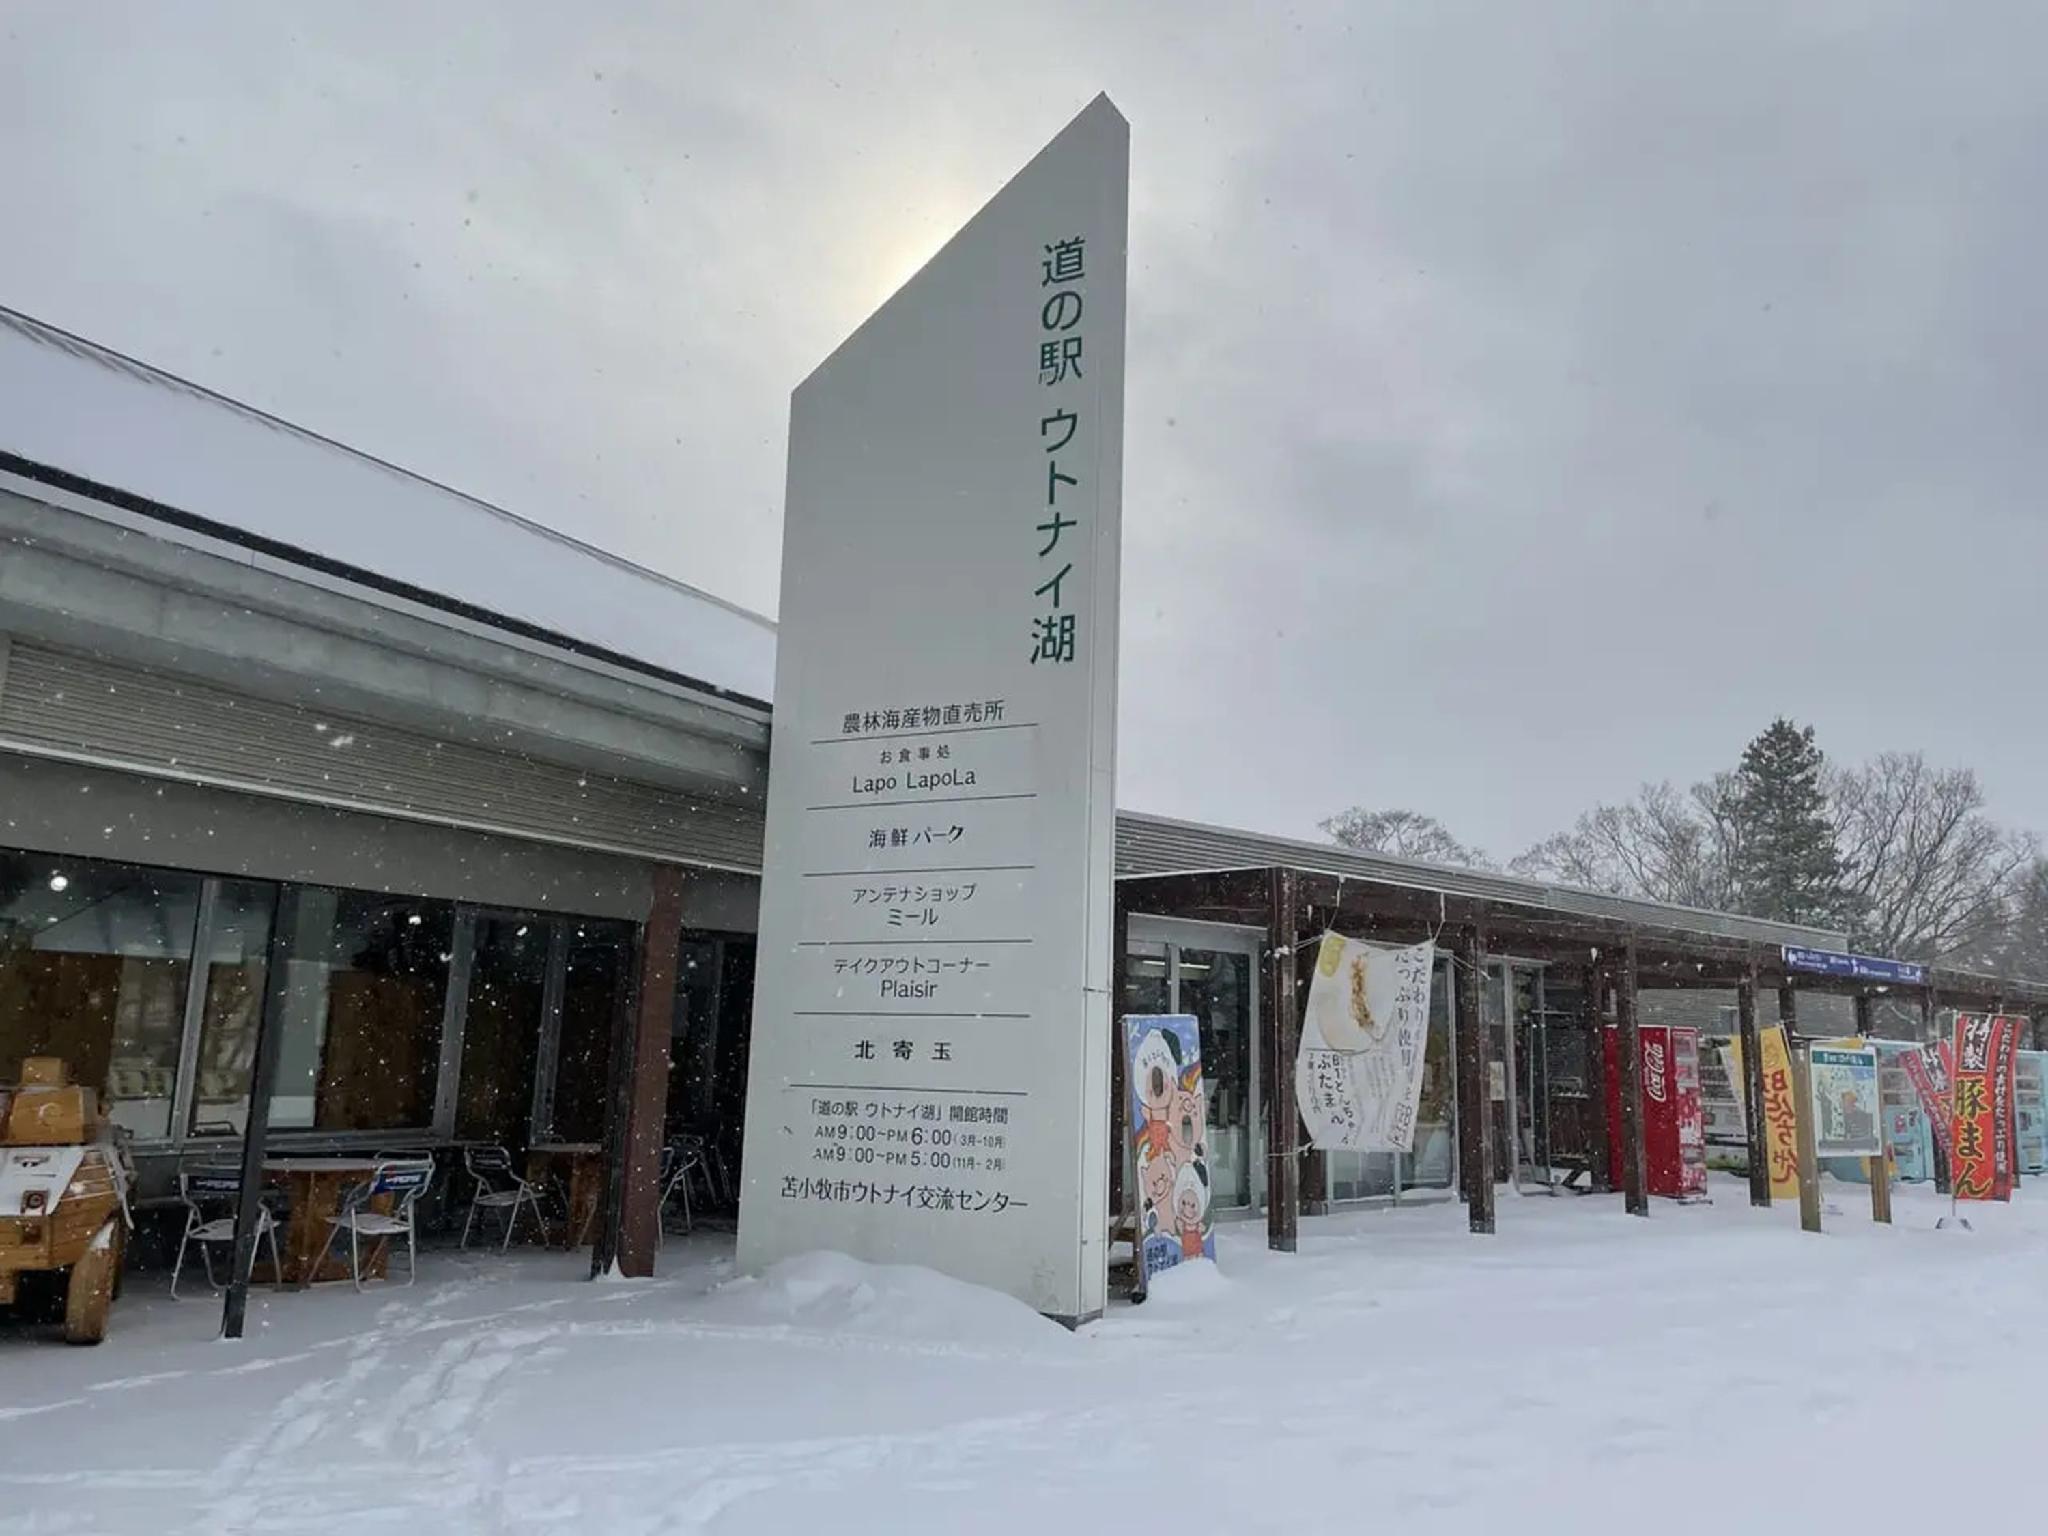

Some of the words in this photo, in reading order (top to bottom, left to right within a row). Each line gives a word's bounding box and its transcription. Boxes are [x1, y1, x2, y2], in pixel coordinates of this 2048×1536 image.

[1038, 236, 1086, 387] 道の駅
[1030, 408, 1078, 664] ウトナイ湖
[841, 700, 1005, 734] 農林海産物直売所
[852, 775, 897, 795] Lapo
[906, 769, 976, 791] LapoLa
[868, 825, 964, 850] 海鮮パーク
[852, 883, 977, 904] アンテナショップ
[887, 908, 939, 927] ミール
[833, 957, 991, 975] テイクアウトコーナー
[880, 979, 938, 999] Plaisir
[1954, 1075, 1993, 1198] 豚まん
[781, 1176, 1029, 1214] 苫小牧市ウトナイ交流センター
